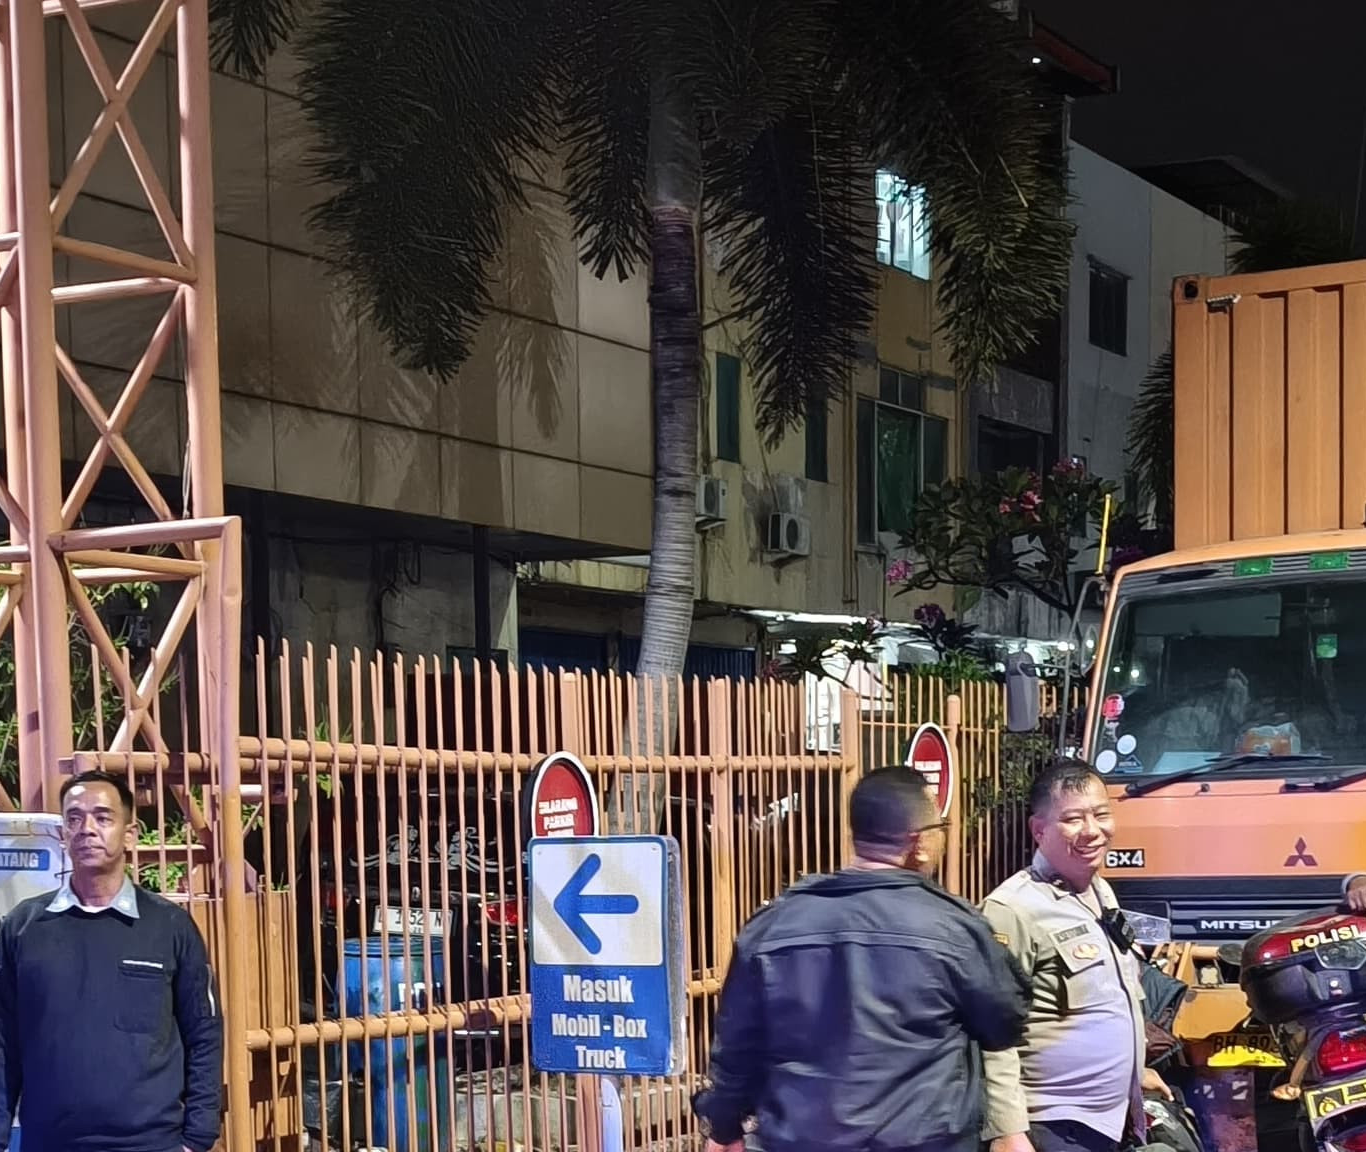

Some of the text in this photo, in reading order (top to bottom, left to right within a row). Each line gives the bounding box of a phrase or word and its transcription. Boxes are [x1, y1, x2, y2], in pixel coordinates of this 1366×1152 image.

[1289, 924, 1361, 953] POLISI
[562, 974, 635, 1003] Masuk
[551, 1013, 601, 1037] Mobil
[612, 1014, 648, 1038] Box
[574, 1045, 627, 1069] Truck
